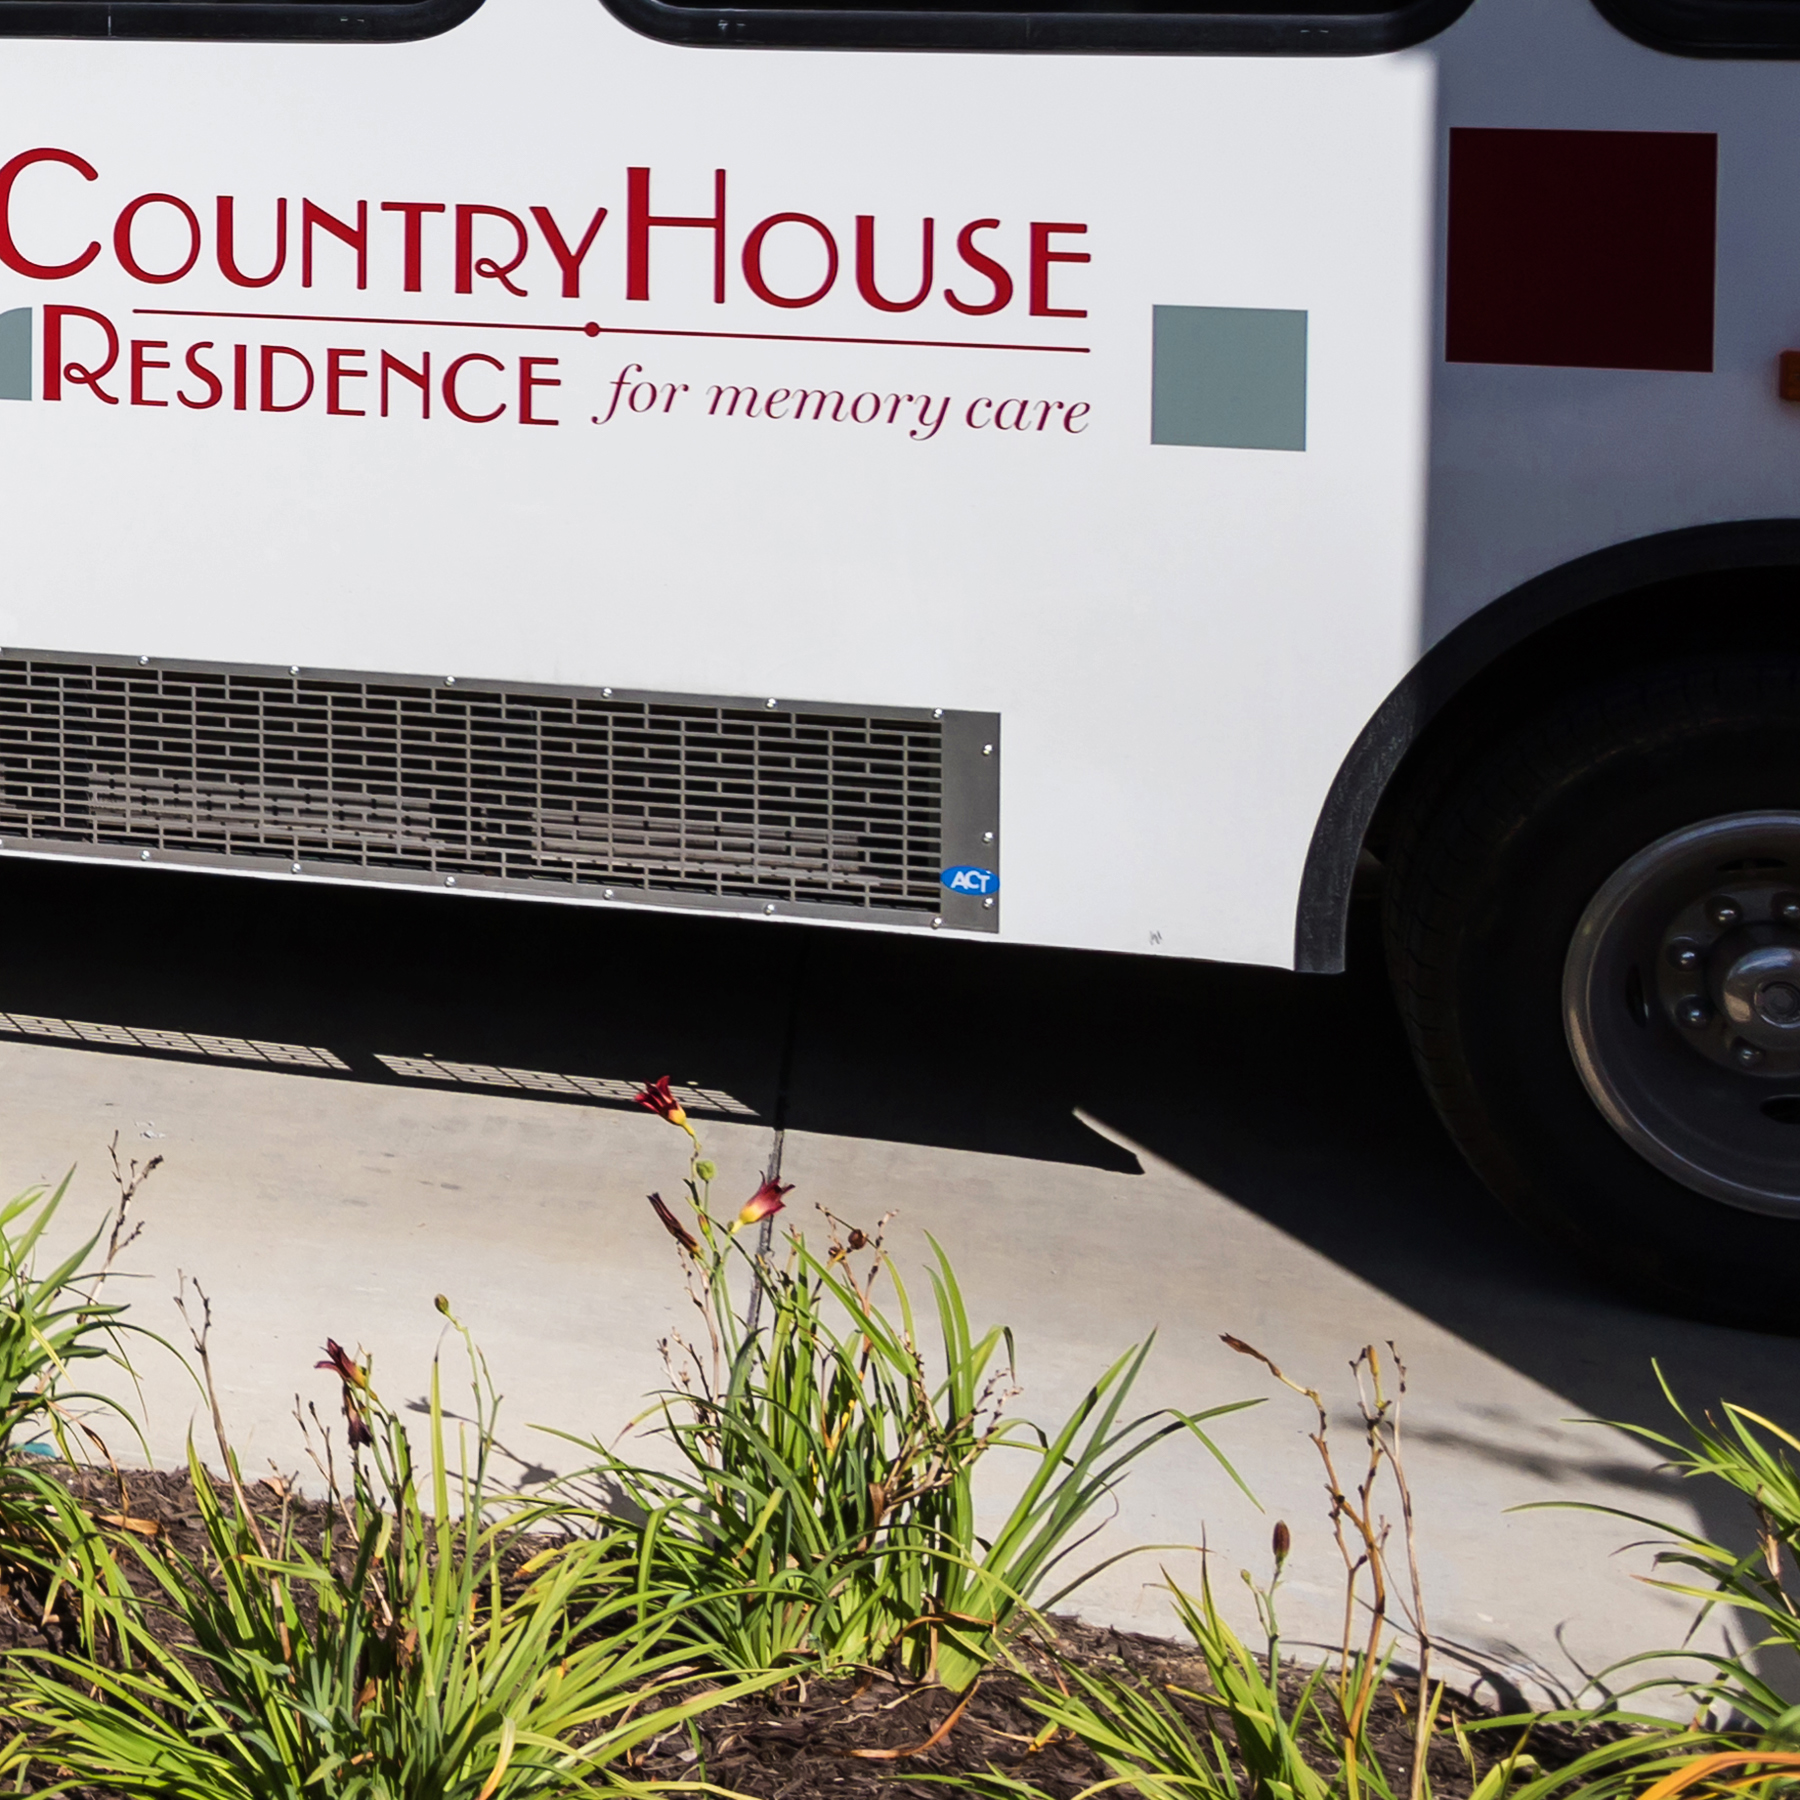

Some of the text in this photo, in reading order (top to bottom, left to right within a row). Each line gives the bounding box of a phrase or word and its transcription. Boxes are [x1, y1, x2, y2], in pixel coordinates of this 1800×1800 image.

[42, 303, 1092, 441] RESIDENCE for memory care
[950, 869, 991, 894] ACT
